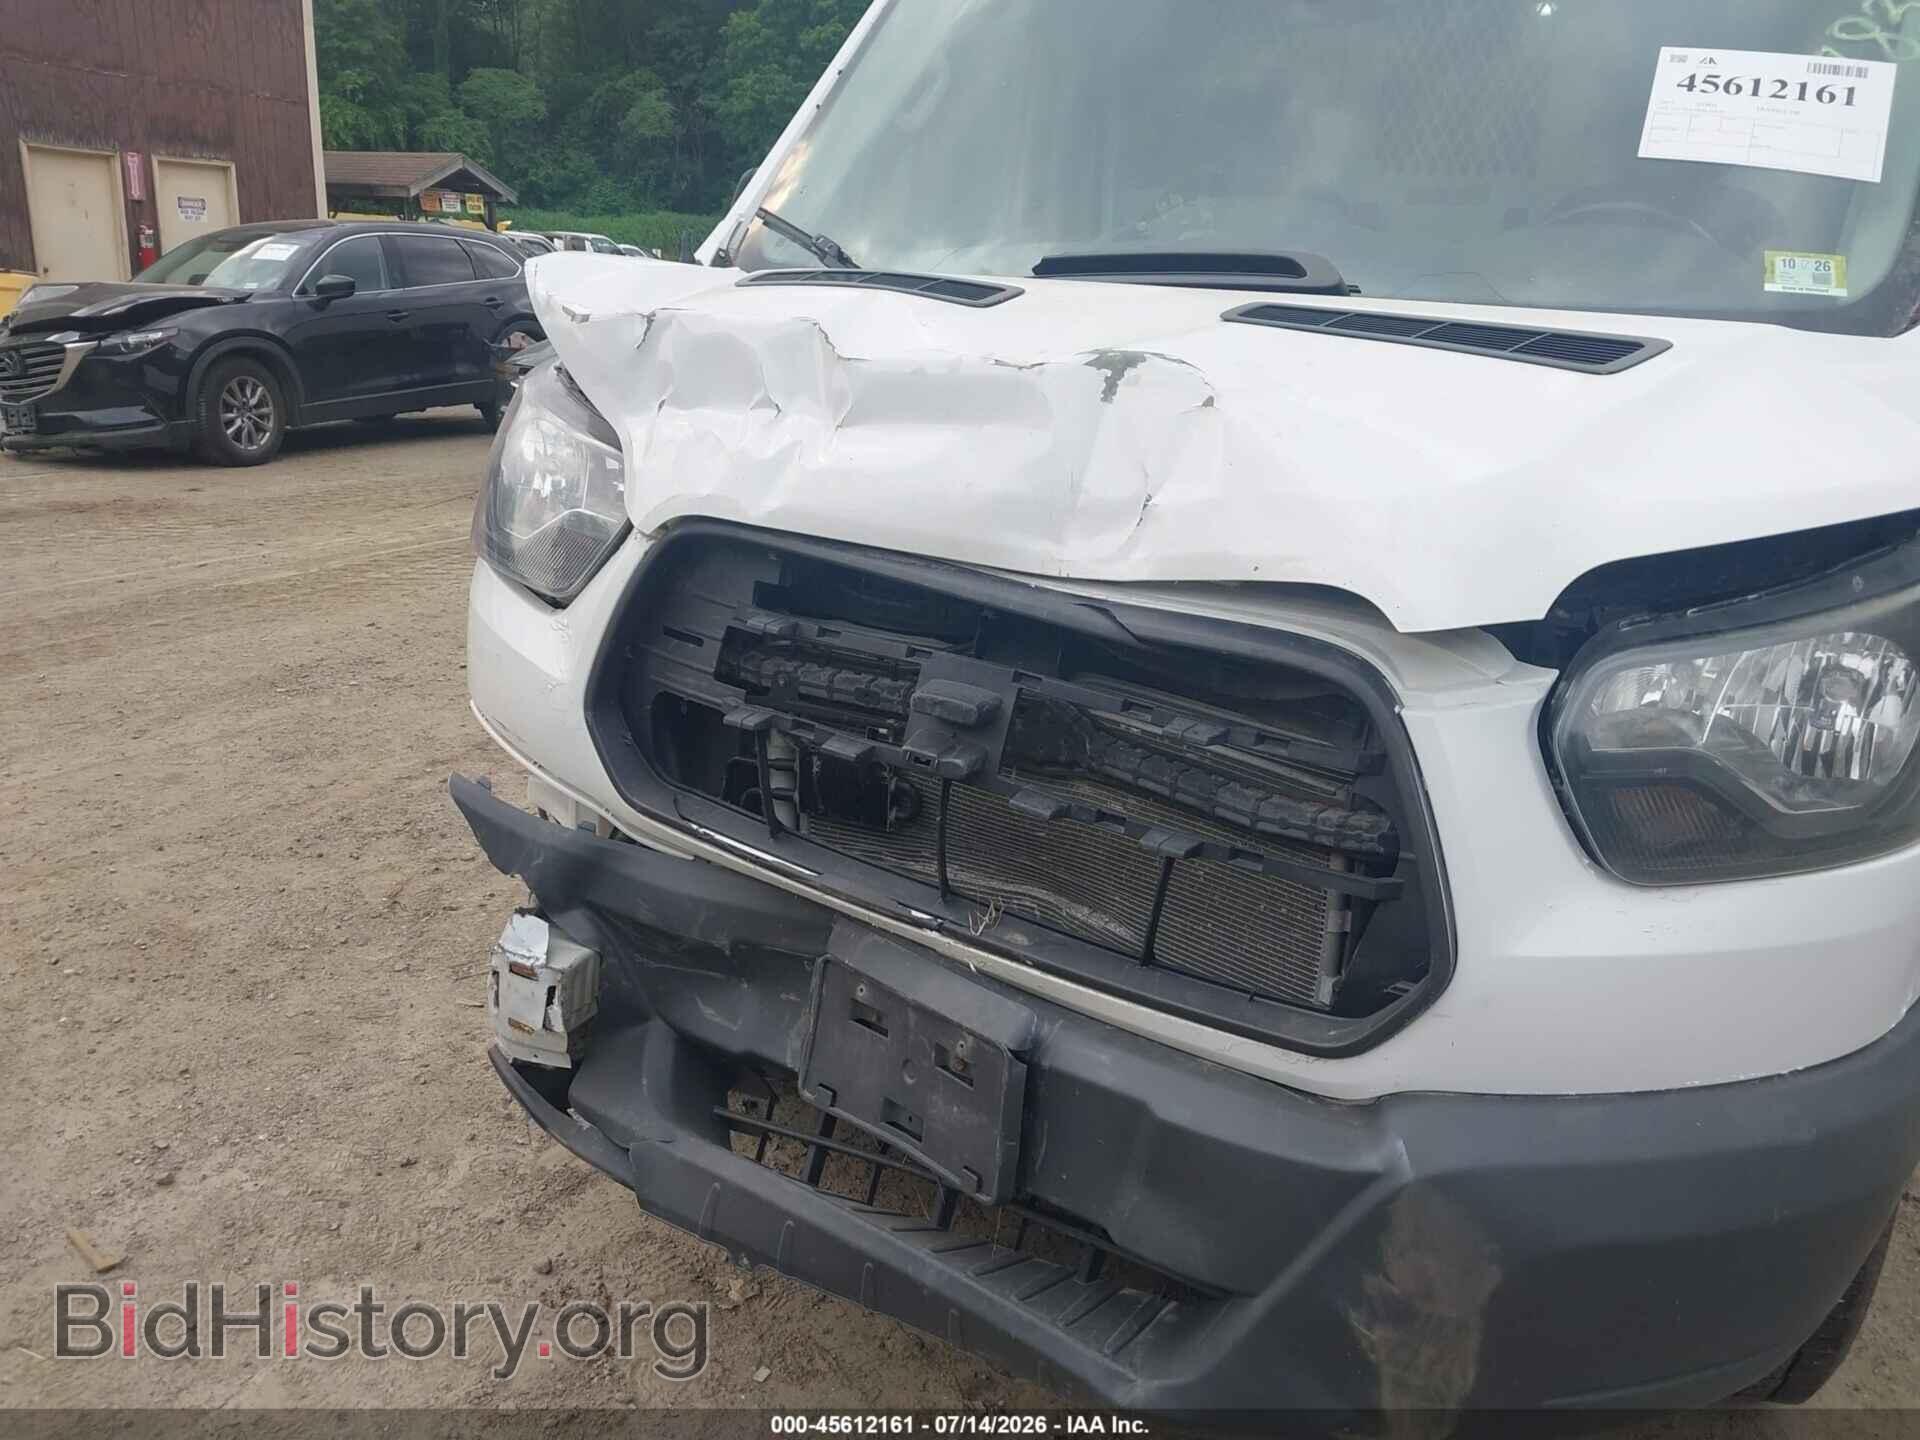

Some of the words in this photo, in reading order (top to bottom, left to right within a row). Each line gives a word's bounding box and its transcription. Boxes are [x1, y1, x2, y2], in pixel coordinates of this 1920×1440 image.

[1676, 73, 1856, 107] 45612161
[1782, 258, 1796, 270] 10
[1814, 260, 1831, 272] 26
